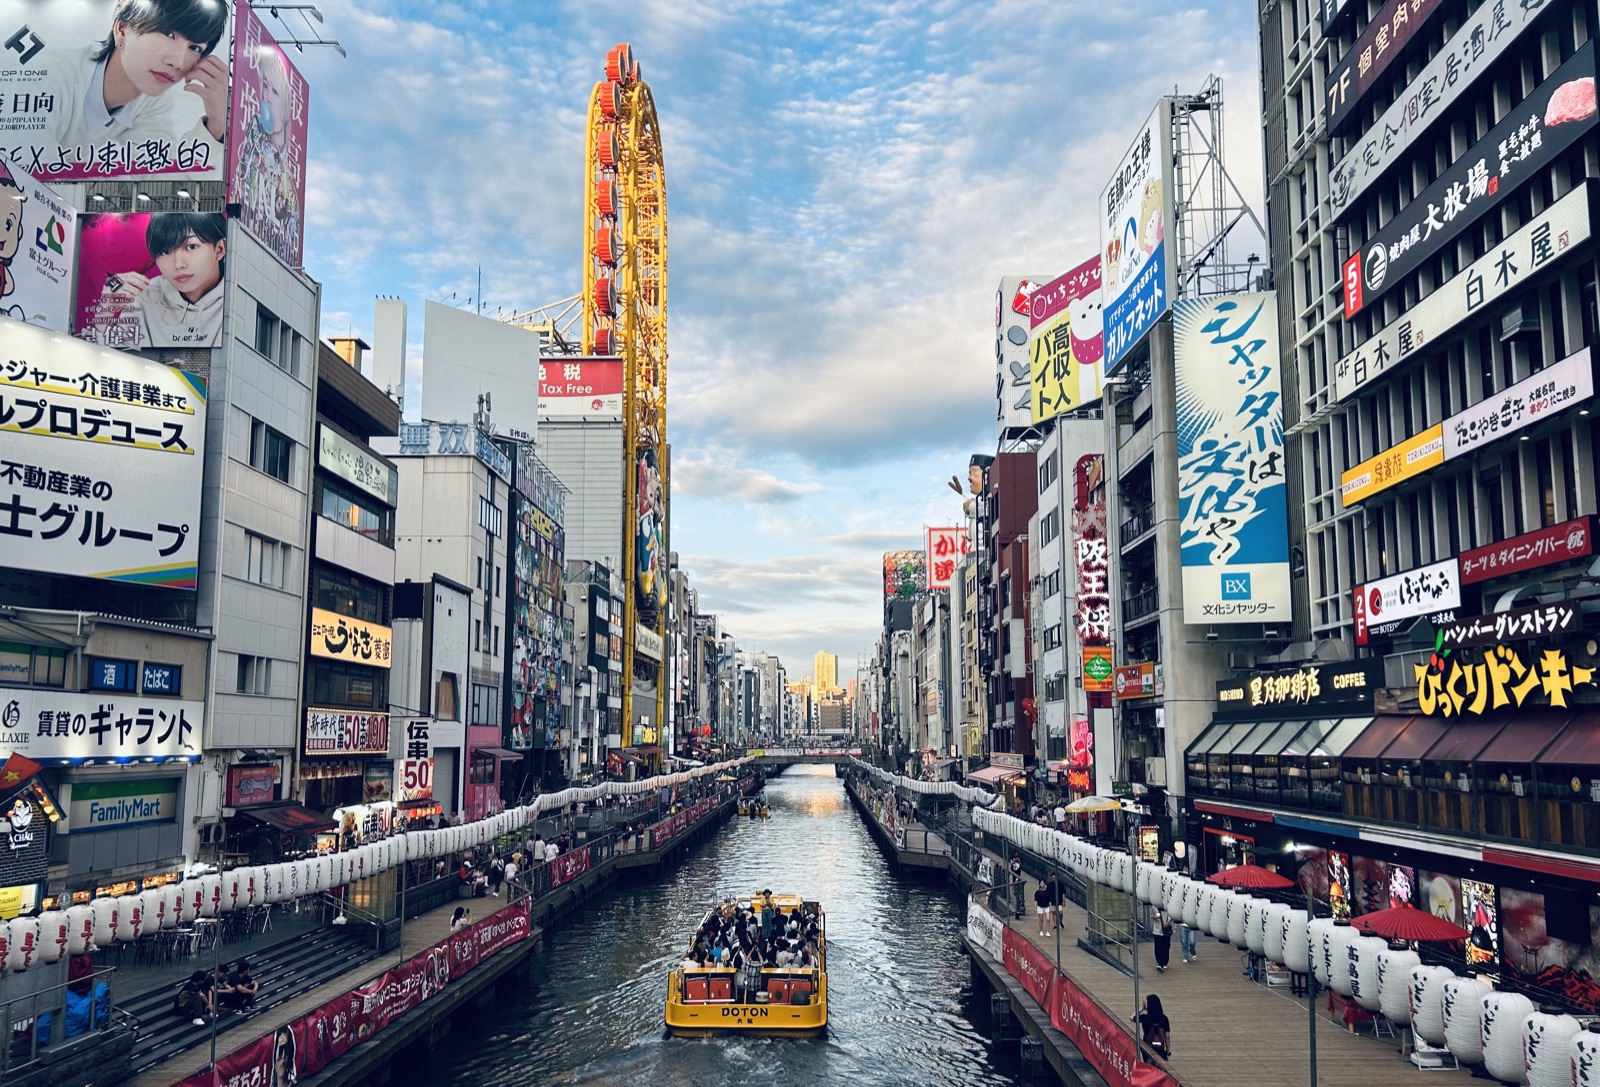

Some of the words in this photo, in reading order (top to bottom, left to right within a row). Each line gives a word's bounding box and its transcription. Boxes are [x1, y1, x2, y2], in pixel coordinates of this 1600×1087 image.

[0, 69, 48, 77] OP1ONE
[1328, 66, 1351, 116] 7F
[287, 66, 304, 189] 最高
[1107, 127, 1151, 217] 店舗の王様
[1388, 223, 1421, 264] 焼肉屋
[1423, 158, 1490, 242] 大牧場
[29, 247, 68, 278] 富士グループ
[1466, 221, 1554, 312] 白木屋
[1347, 261, 1358, 311] 5F
[1107, 280, 1163, 366] ガルフネット
[1337, 358, 1350, 379] 4F
[1354, 320, 1415, 386] 白木屋
[542, 383, 563, 394] Tax
[567, 383, 593, 394] Free
[1070, 503, 1110, 639] 大阪王将
[1225, 579, 1247, 593] BX
[1356, 595, 1365, 637] 2F
[1443, 605, 1573, 644] ハンバーグレストラン
[325, 618, 373, 659] うなぎ
[103, 664, 116, 686] 酒
[143, 667, 170, 689] たばこ
[1249, 666, 1321, 707] 星乃珈琲店
[1333, 672, 1366, 688] COFFEE
[1414, 645, 1598, 717] びっくりドンキー
[0, 732, 30, 743] LAXIE
[37, 703, 193, 745] 賃貸のギャラント
[311, 713, 338, 737] 新時代
[344, 715, 360, 750] 50
[406, 720, 430, 760] 伝串
[404, 760, 430, 790] 50
[90, 797, 161, 824] FamilyMart
[721, 1007, 769, 1017] DOTON
